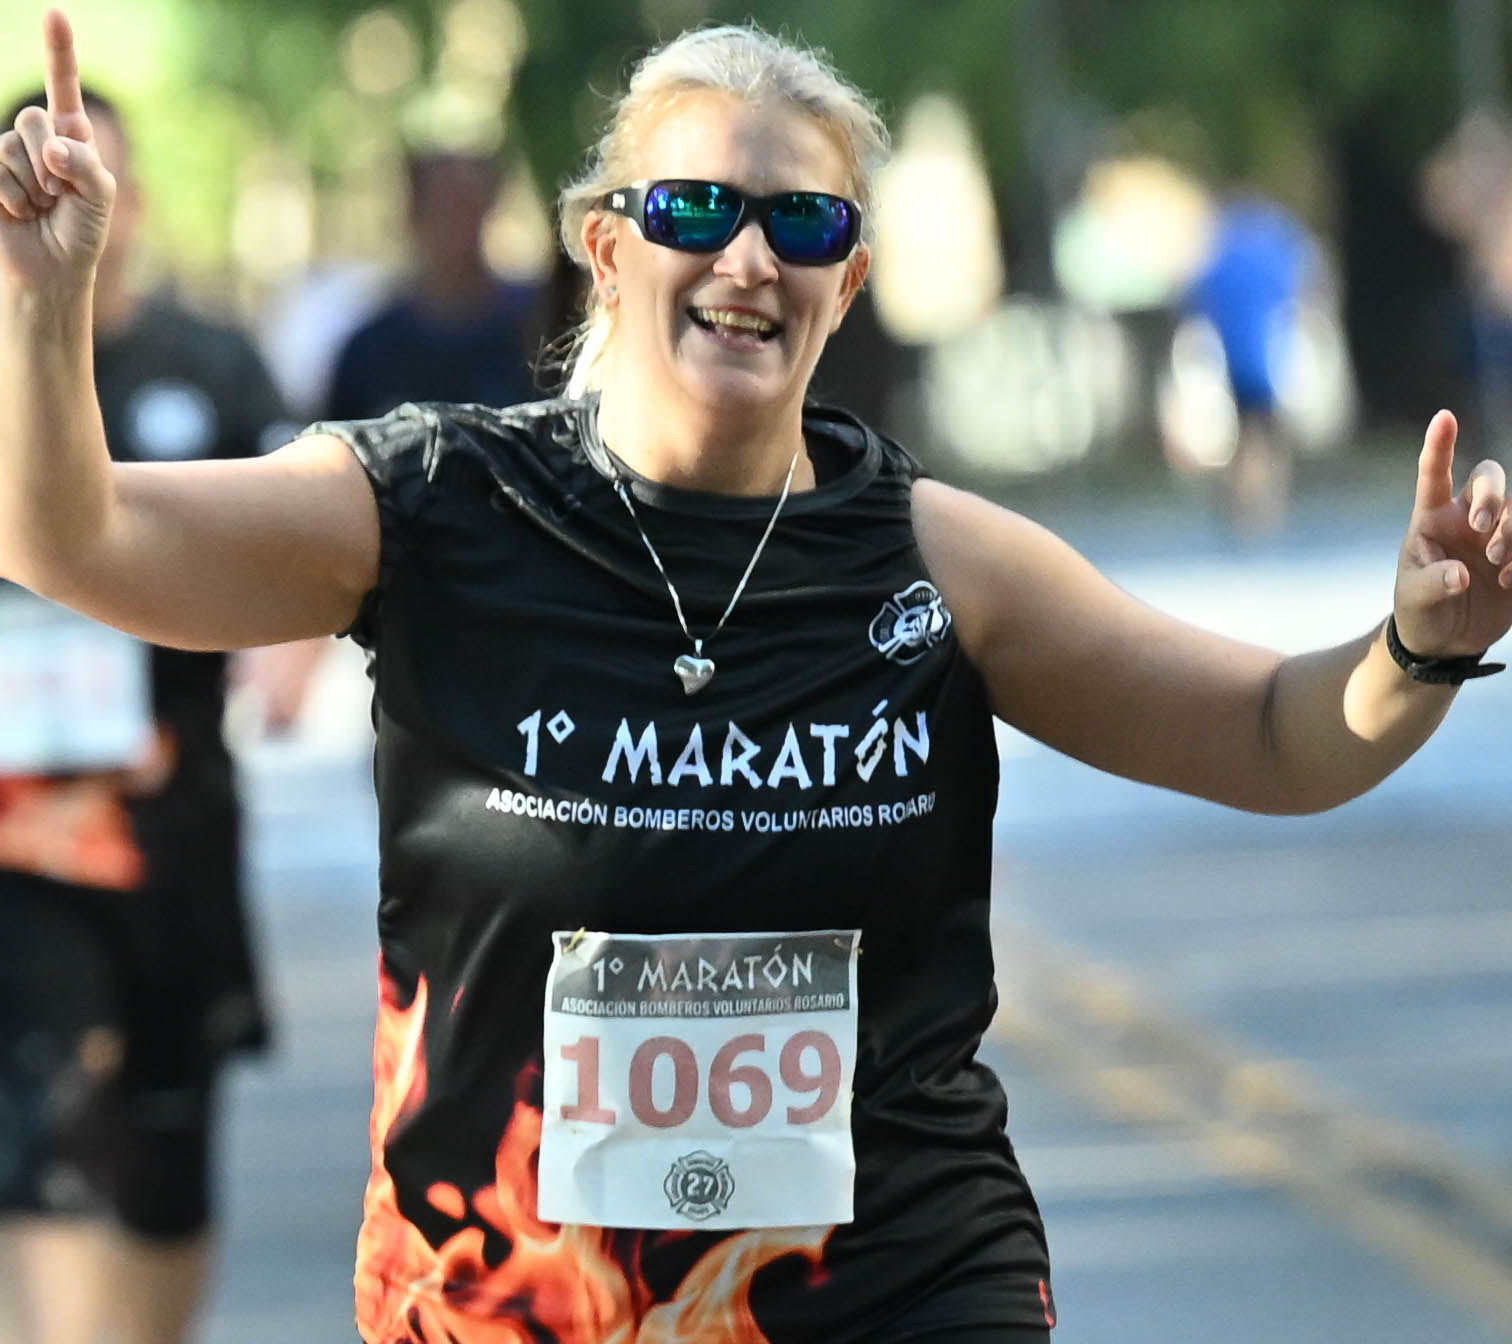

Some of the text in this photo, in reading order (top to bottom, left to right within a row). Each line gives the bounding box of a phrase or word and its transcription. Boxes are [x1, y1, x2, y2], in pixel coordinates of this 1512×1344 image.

[601, 699, 930, 790] MARATÓN
[486, 787, 608, 826] ASOCIACIÓN
[614, 806, 735, 831] BOMBEROS
[637, 944, 813, 993] MARATÓN
[639, 999, 710, 1017] BOMBEROS
[794, 993, 844, 1011] ROSARIO
[560, 1030, 842, 1128] 1069
[687, 1172, 715, 1197] 27
